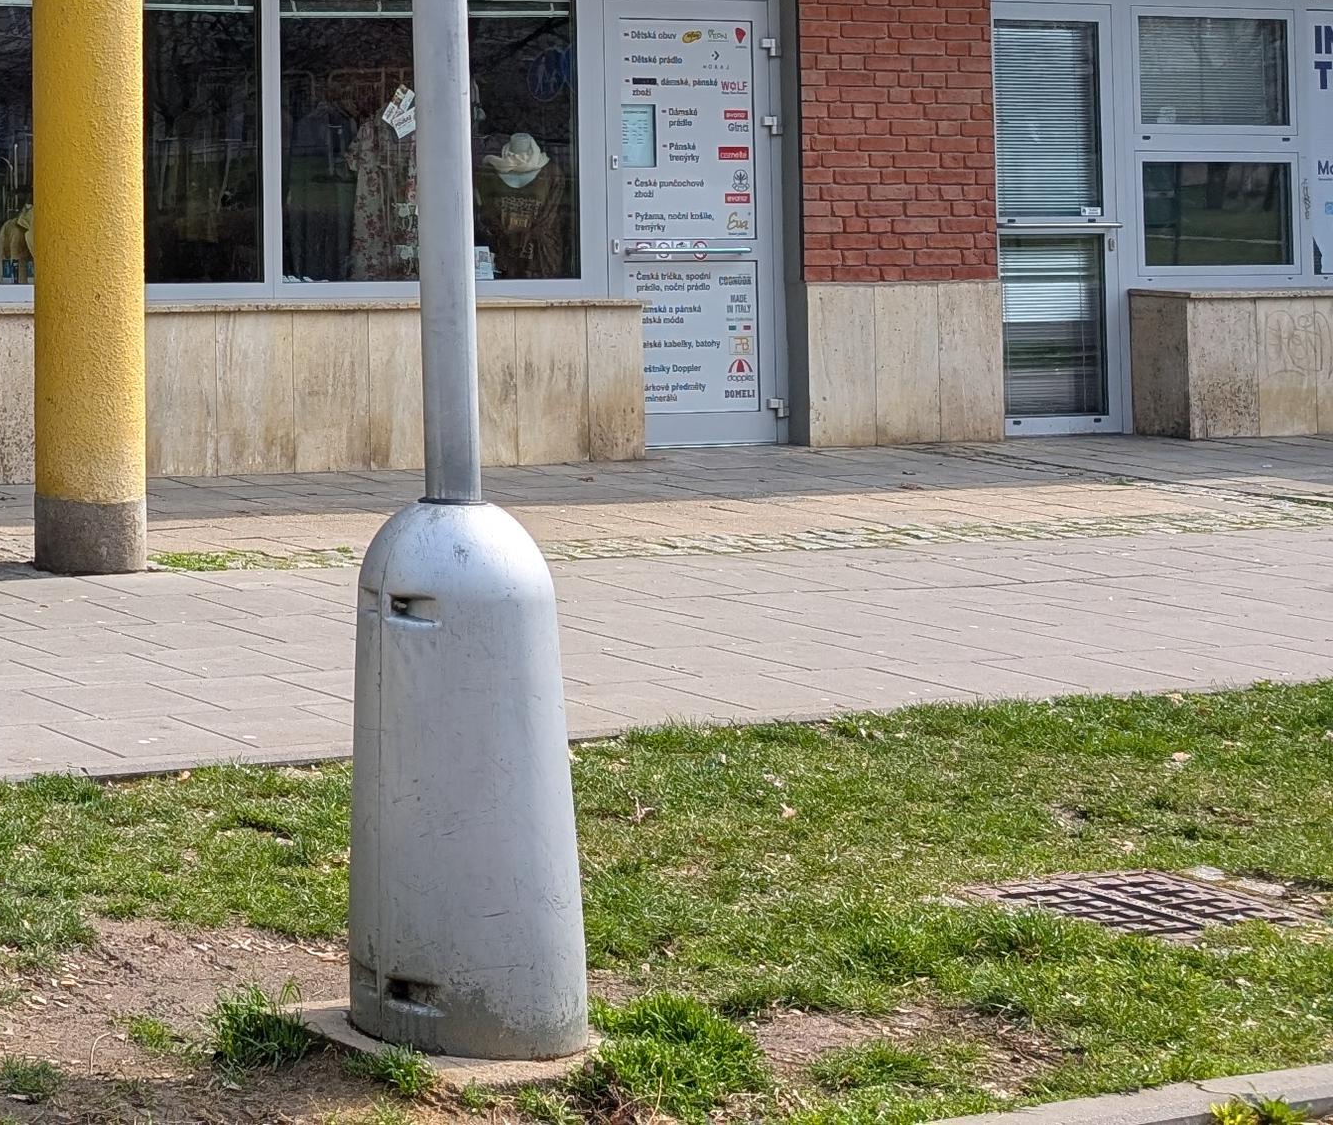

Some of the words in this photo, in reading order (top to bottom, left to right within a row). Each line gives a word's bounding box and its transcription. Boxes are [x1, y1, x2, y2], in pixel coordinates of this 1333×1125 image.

[721, 81, 748, 91] WOLF
[642, 305, 667, 314] ámská
[642, 316, 662, 324] alská
[643, 364, 670, 374] eštníky
[644, 382, 670, 391] árkové
